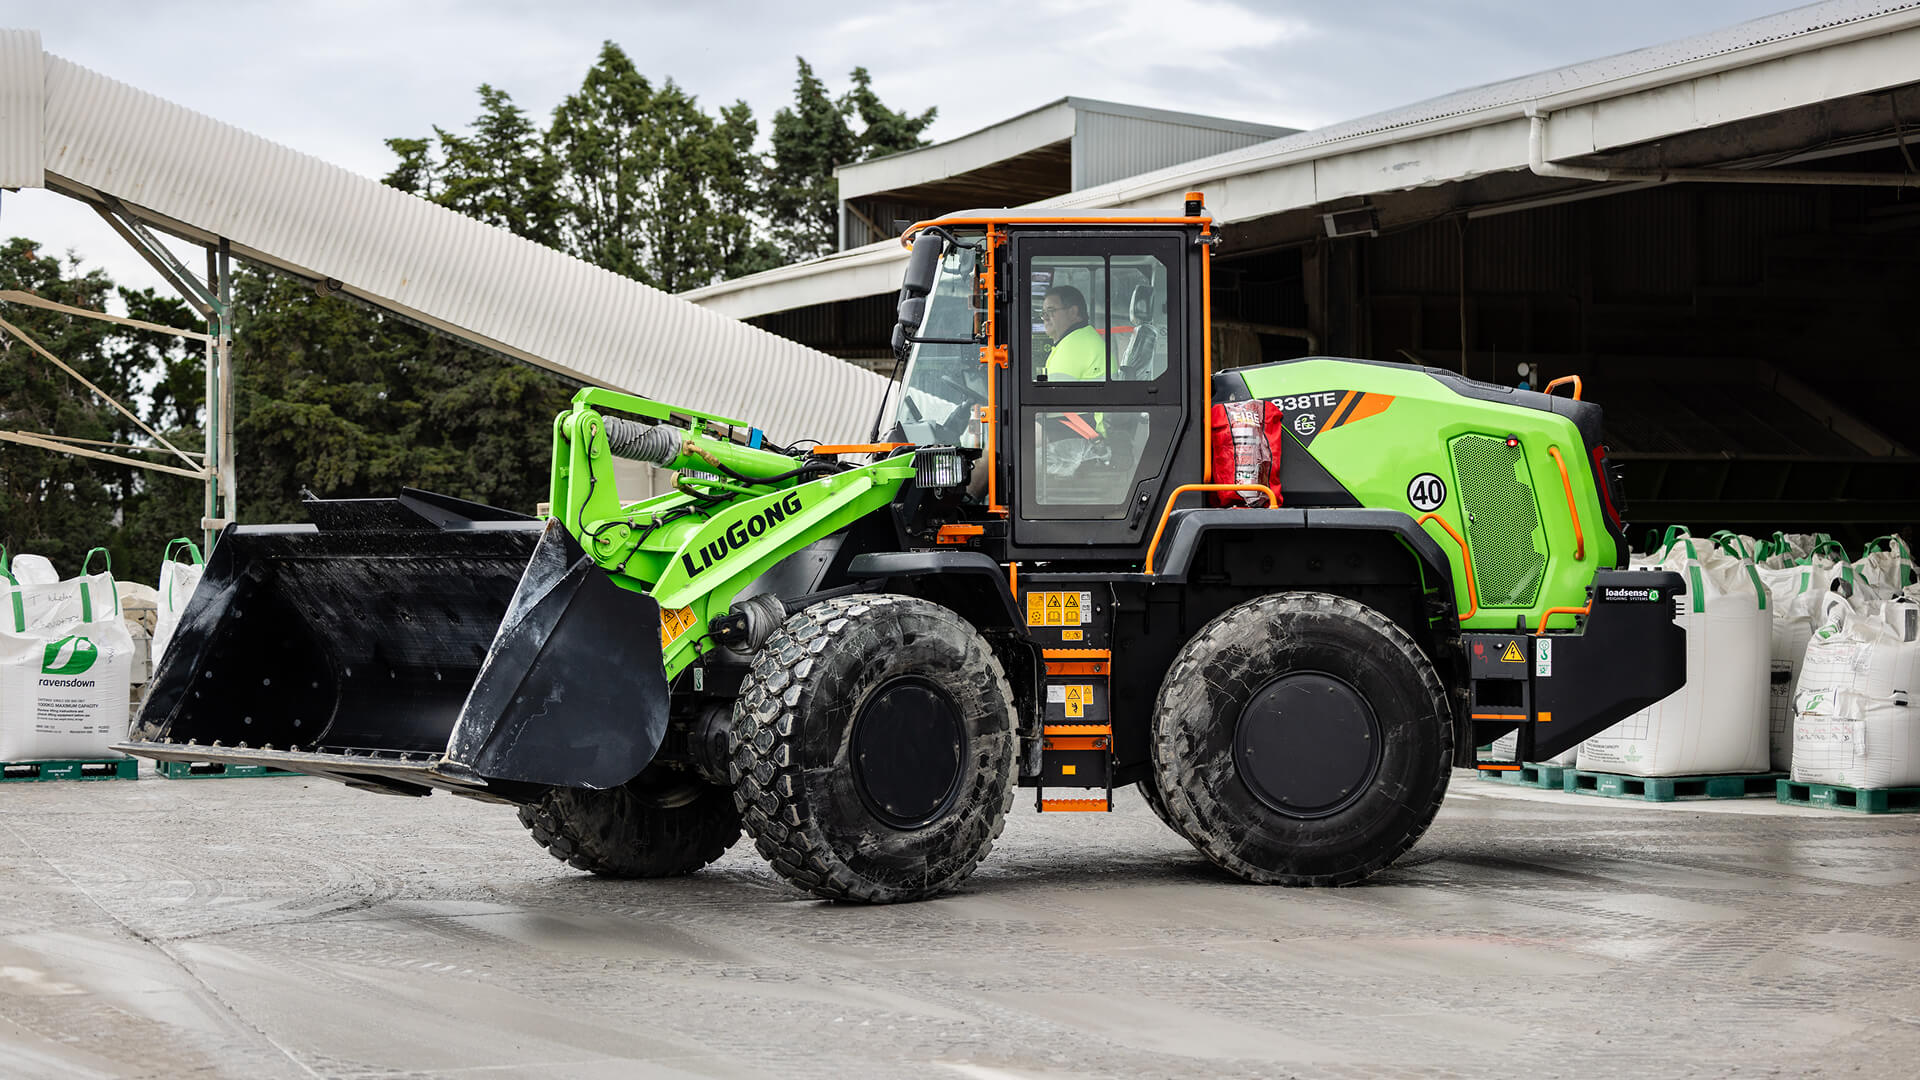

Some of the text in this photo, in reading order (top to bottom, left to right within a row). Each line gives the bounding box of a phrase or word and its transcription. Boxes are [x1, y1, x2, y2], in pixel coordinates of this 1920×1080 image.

[1413, 480, 1442, 505] 40
[1605, 588, 1648, 597] loadsense
[38, 678, 95, 688] ravensdown
